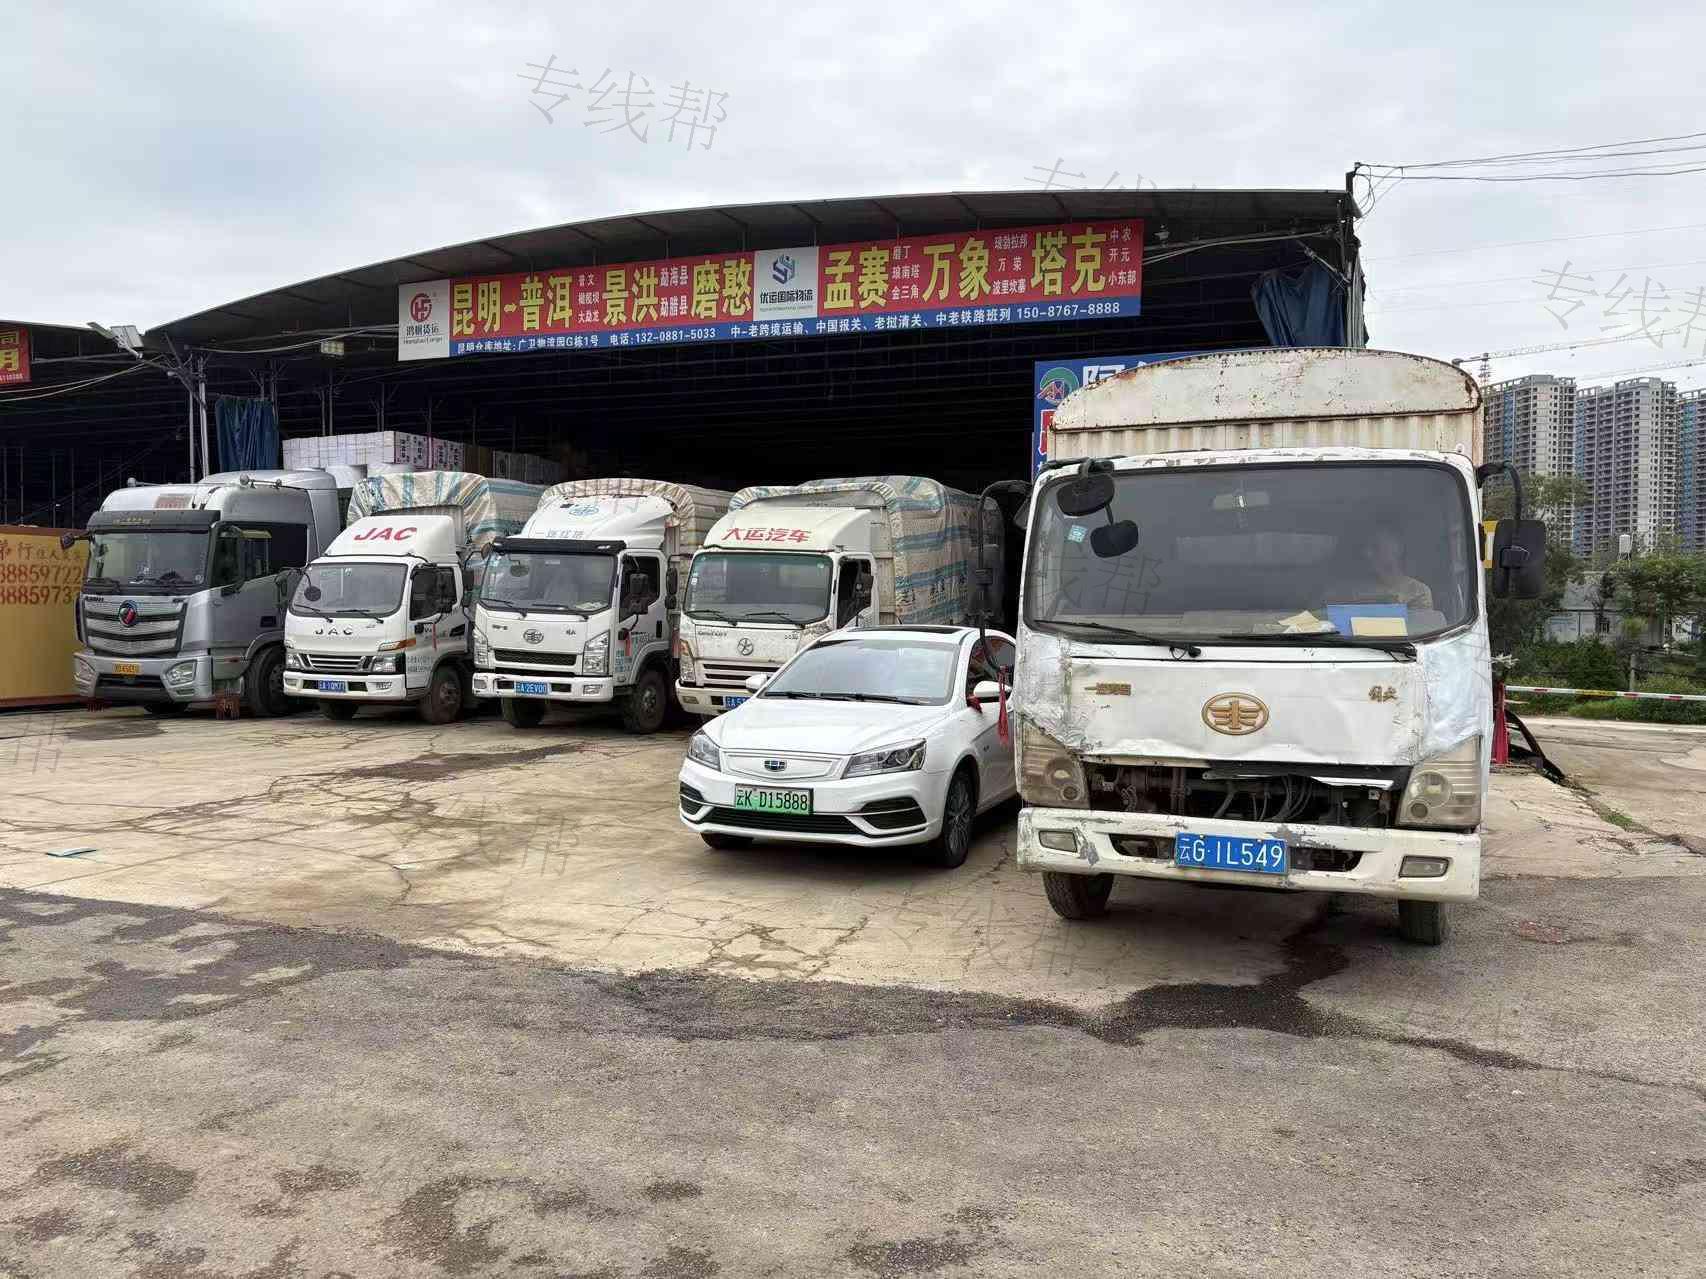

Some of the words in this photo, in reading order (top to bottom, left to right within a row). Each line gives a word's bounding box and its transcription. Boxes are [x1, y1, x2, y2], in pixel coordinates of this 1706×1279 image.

[602, 266, 658, 326] 景洪
[691, 259, 753, 319] 磨憨
[823, 247, 890, 309] 孟赛
[922, 238, 992, 302] 万象
[1030, 227, 1107, 296] 塔克
[760, 288, 813, 304] 优运国际物流
[891, 284, 920, 300] 金三角
[1016, 302, 1121, 319] 150-8767-8888
[354, 527, 417, 540] JAC
[722, 528, 811, 542] 大运汽车
[314, 626, 354, 636] JAC
